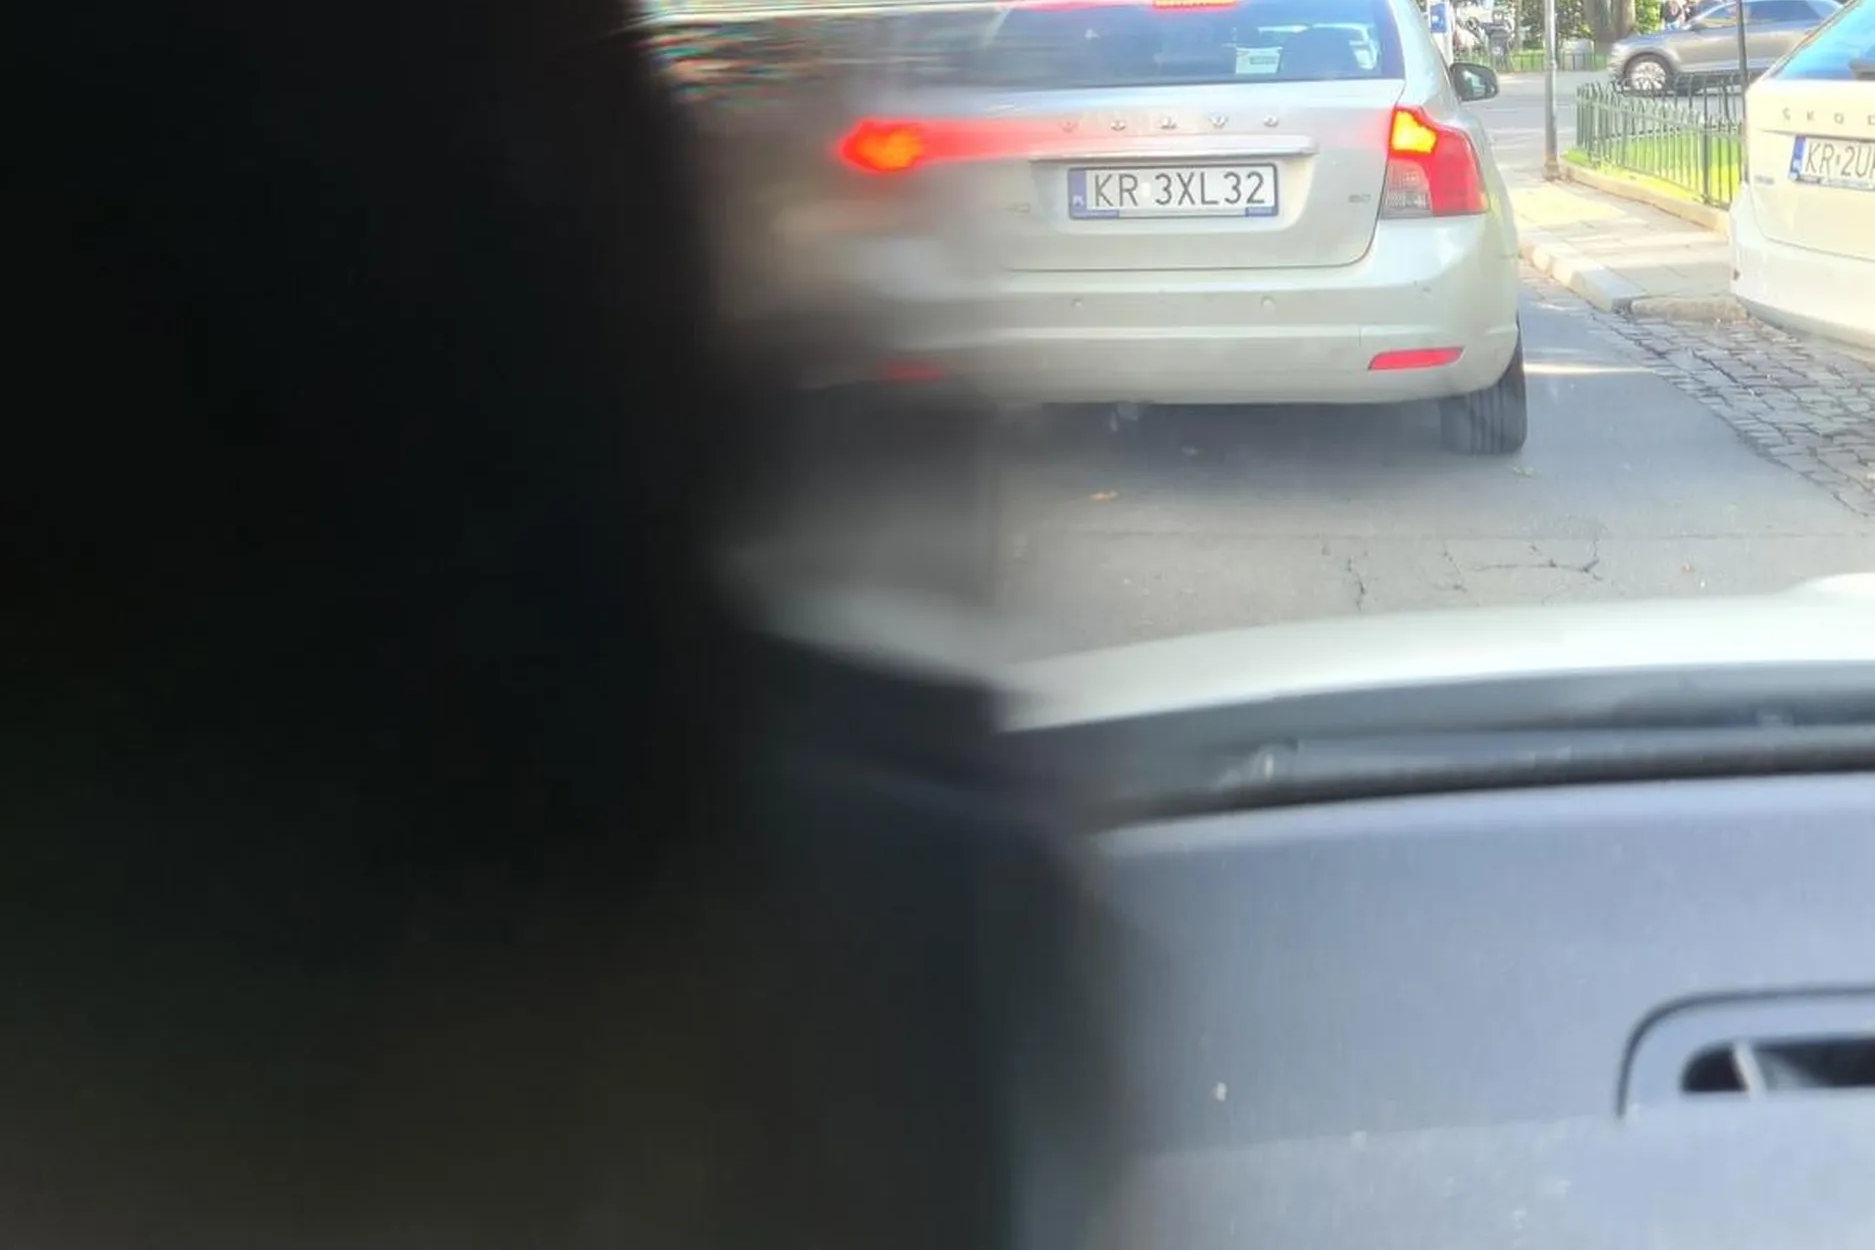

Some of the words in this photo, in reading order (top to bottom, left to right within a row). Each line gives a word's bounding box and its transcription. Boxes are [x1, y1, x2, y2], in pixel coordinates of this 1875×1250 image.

[1805, 141, 1835, 175] KR
[1094, 173, 1139, 207] KR
[1154, 170, 1266, 206] 3XL32
